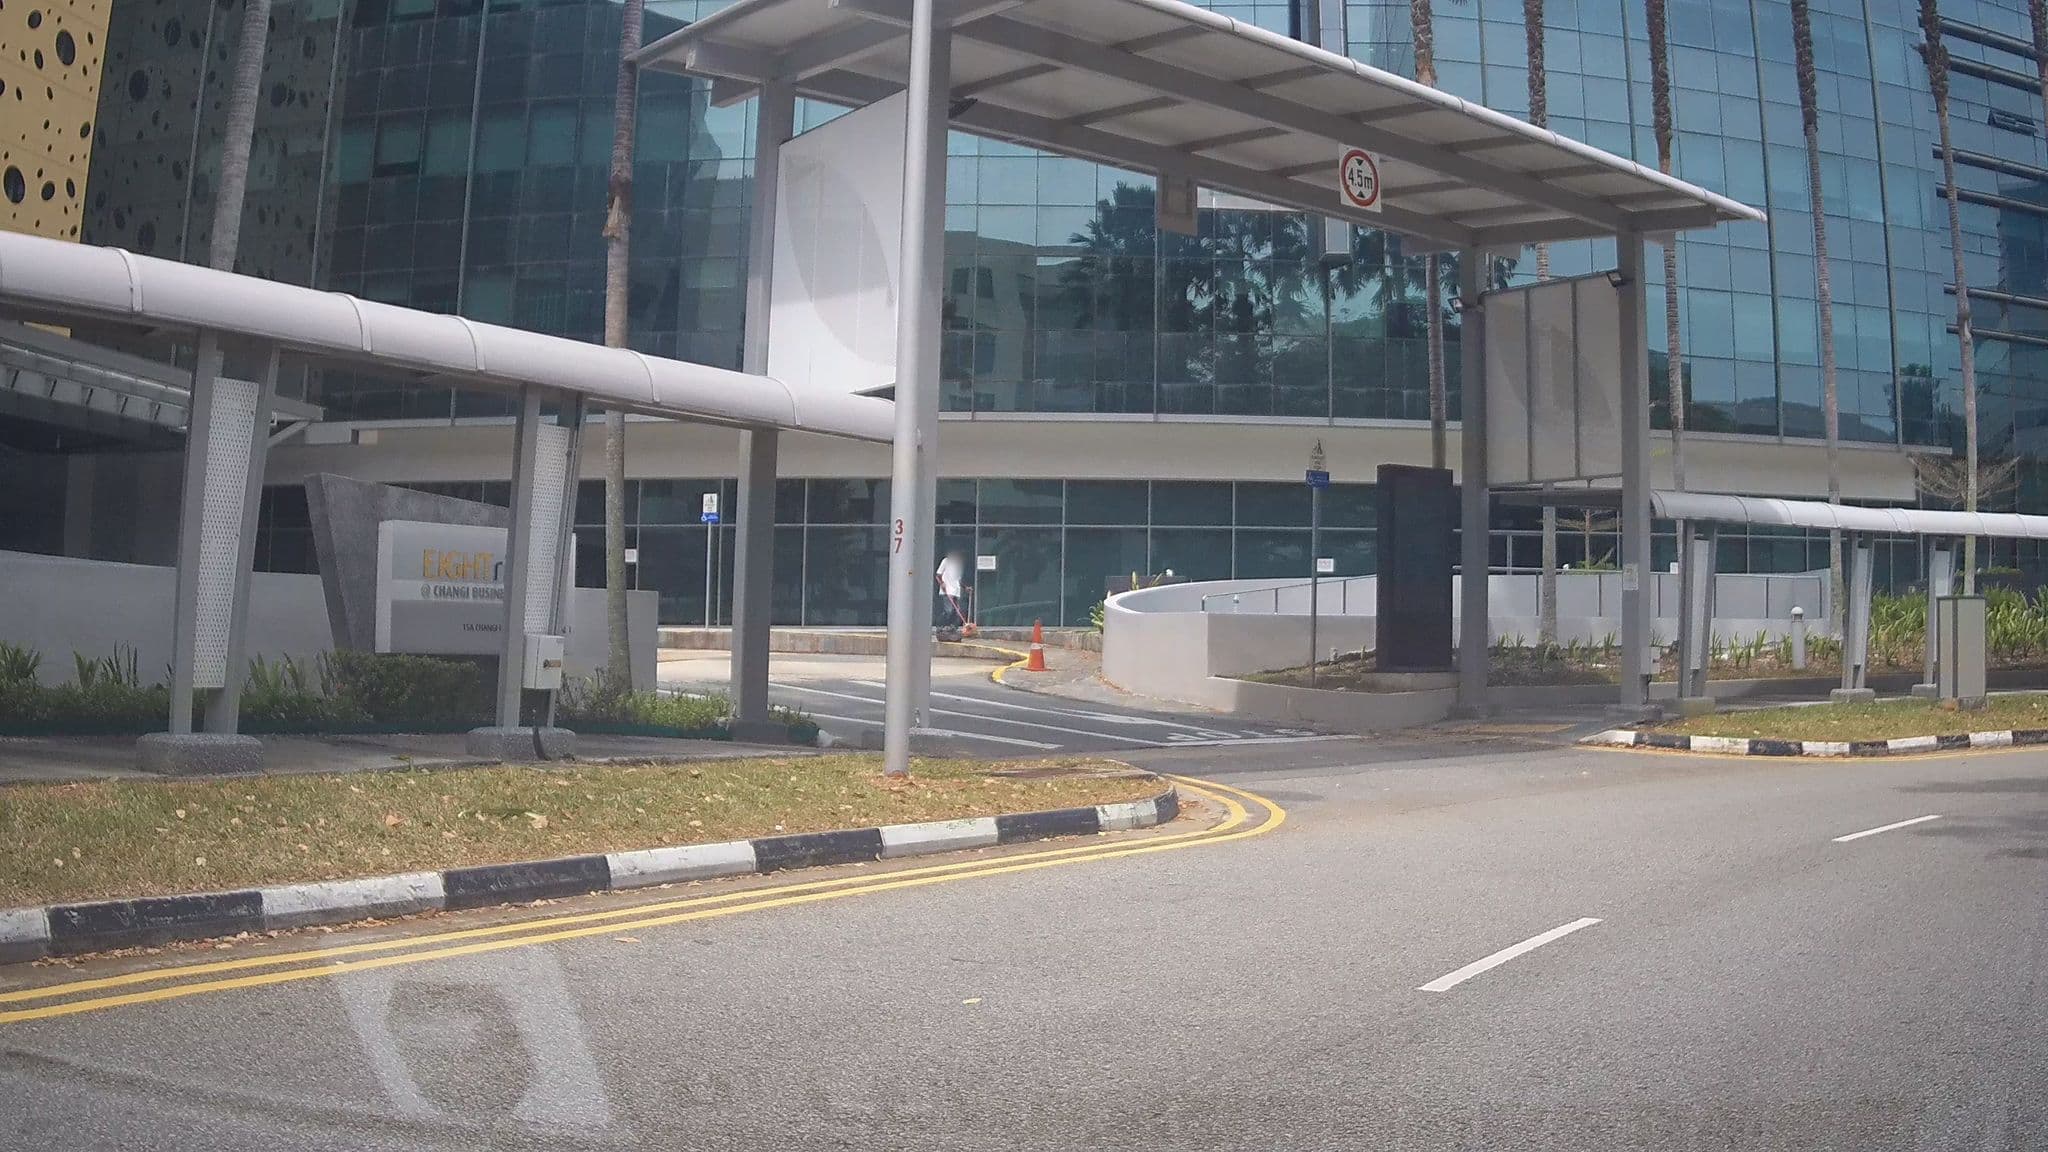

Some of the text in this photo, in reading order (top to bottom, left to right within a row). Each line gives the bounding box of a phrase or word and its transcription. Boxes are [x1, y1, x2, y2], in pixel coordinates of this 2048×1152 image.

[1348, 168, 1373, 190] 4.5m
[421, 584, 431, 598] @
[433, 585, 470, 599] CHANGI
